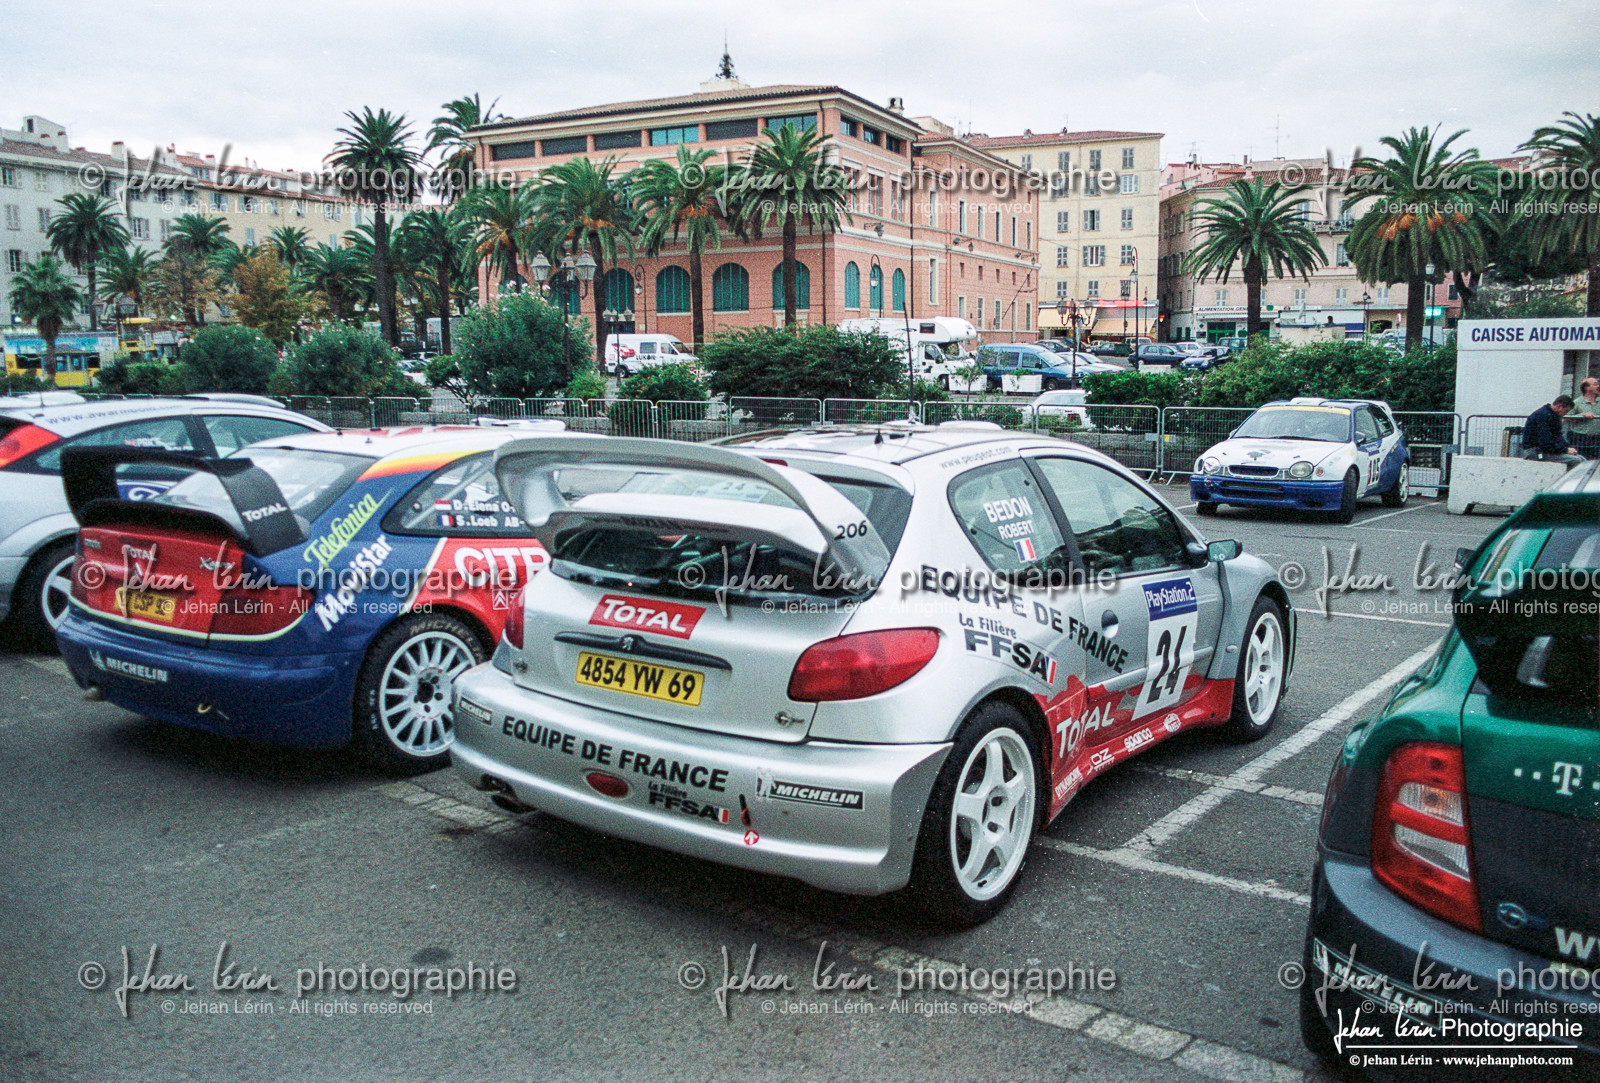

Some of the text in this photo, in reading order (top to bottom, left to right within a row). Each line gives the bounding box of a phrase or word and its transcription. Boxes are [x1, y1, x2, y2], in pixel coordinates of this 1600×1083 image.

[1471, 326, 1600, 342] CAISSE AUTOMAT
[241, 502, 288, 522] TOTAL
[983, 496, 1033, 523] BEDON
[834, 520, 868, 541] 206
[997, 519, 1034, 540] ROBERT
[602, 597, 689, 633] TOTAL
[921, 564, 1129, 674] EQUIPE DE FRANCE
[959, 612, 1017, 639] La Filière
[964, 628, 1047, 682] FFSA
[1147, 625, 1187, 704] 24
[106, 656, 168, 683] MICHELIN
[579, 655, 696, 701] 4854 YW 69
[1056, 701, 1115, 759] TOTAL
[502, 715, 729, 792] EQUIPE DE FRANCE
[1091, 747, 1113, 766] OZ
[649, 790, 719, 822] FFSA
[776, 783, 860, 804] MICHELIN
